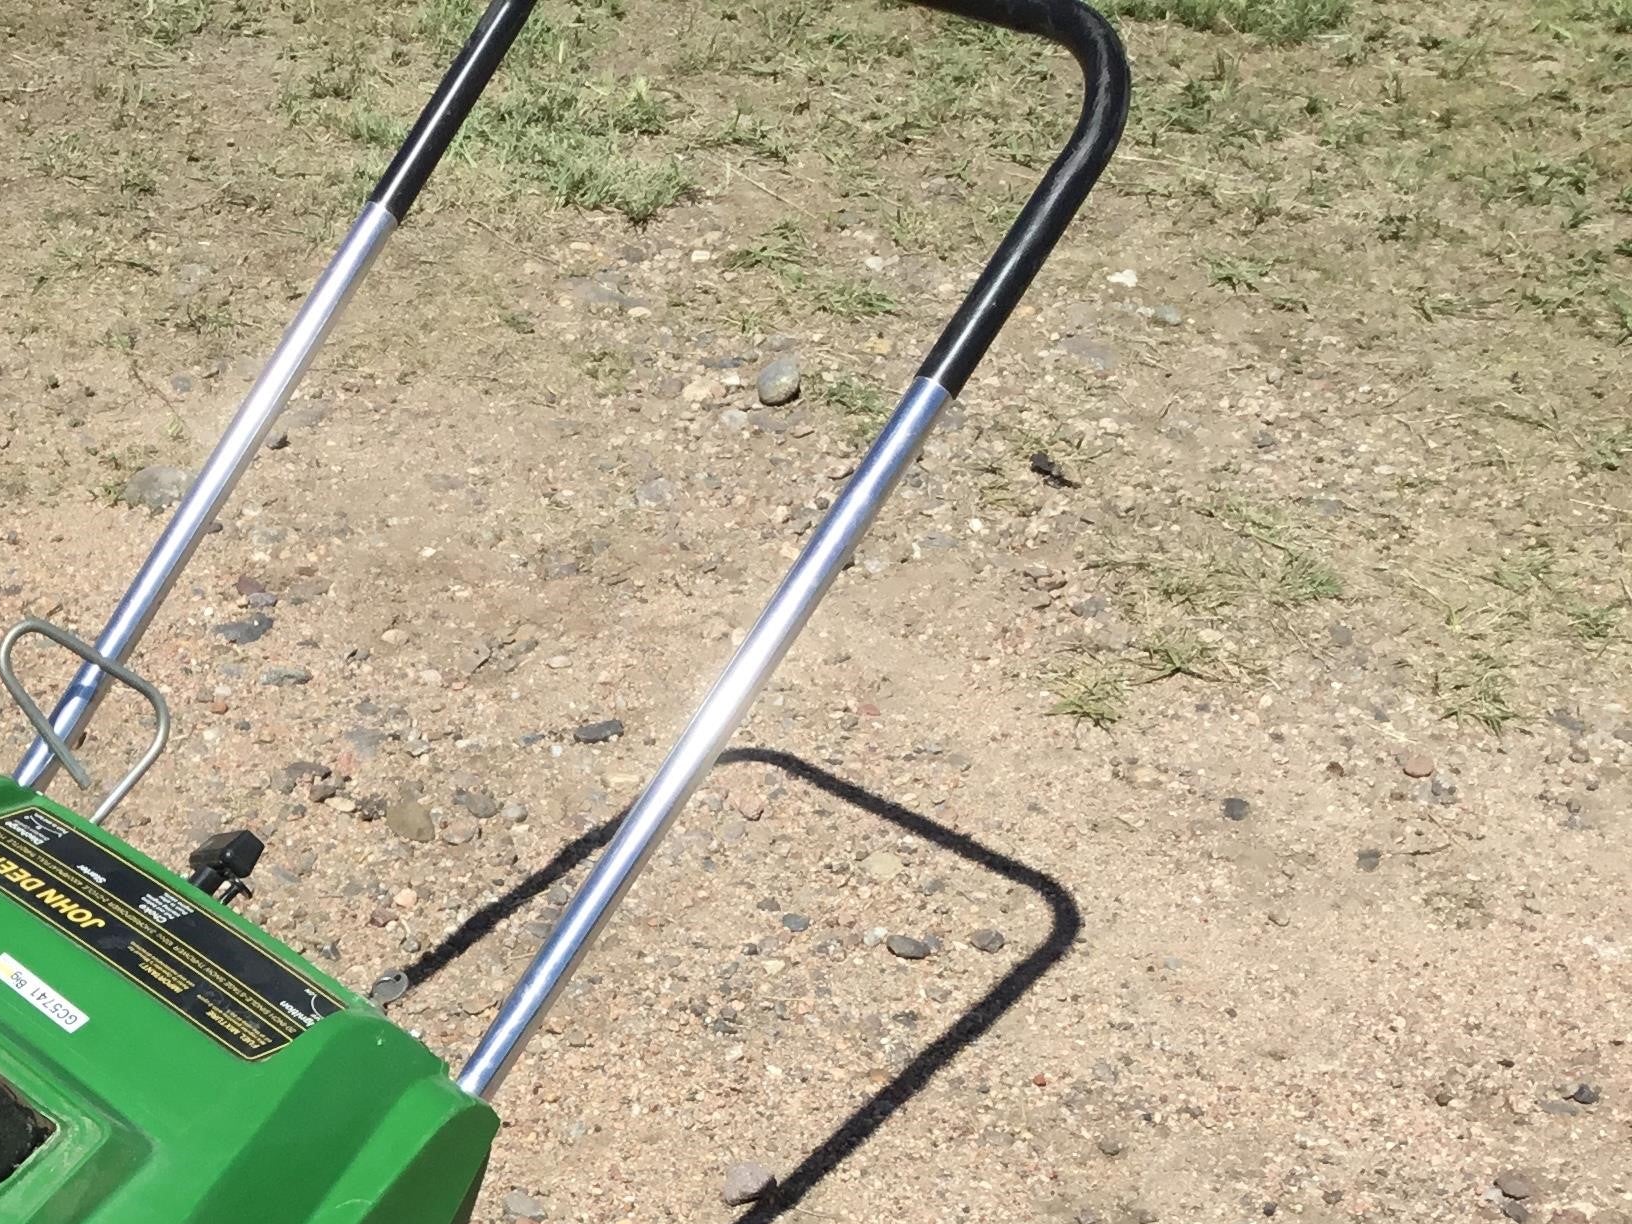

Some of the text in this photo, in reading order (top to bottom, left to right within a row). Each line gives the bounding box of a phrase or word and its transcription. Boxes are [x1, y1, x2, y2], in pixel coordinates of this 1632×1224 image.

[73, 862, 108, 883] Starter
[35, 889, 107, 931] JOHN
[134, 902, 169, 924] Choke
[29, 987, 78, 1025] GC5741
[275, 999, 317, 1026] Ignition
[236, 1032, 261, 1048] FUEL
